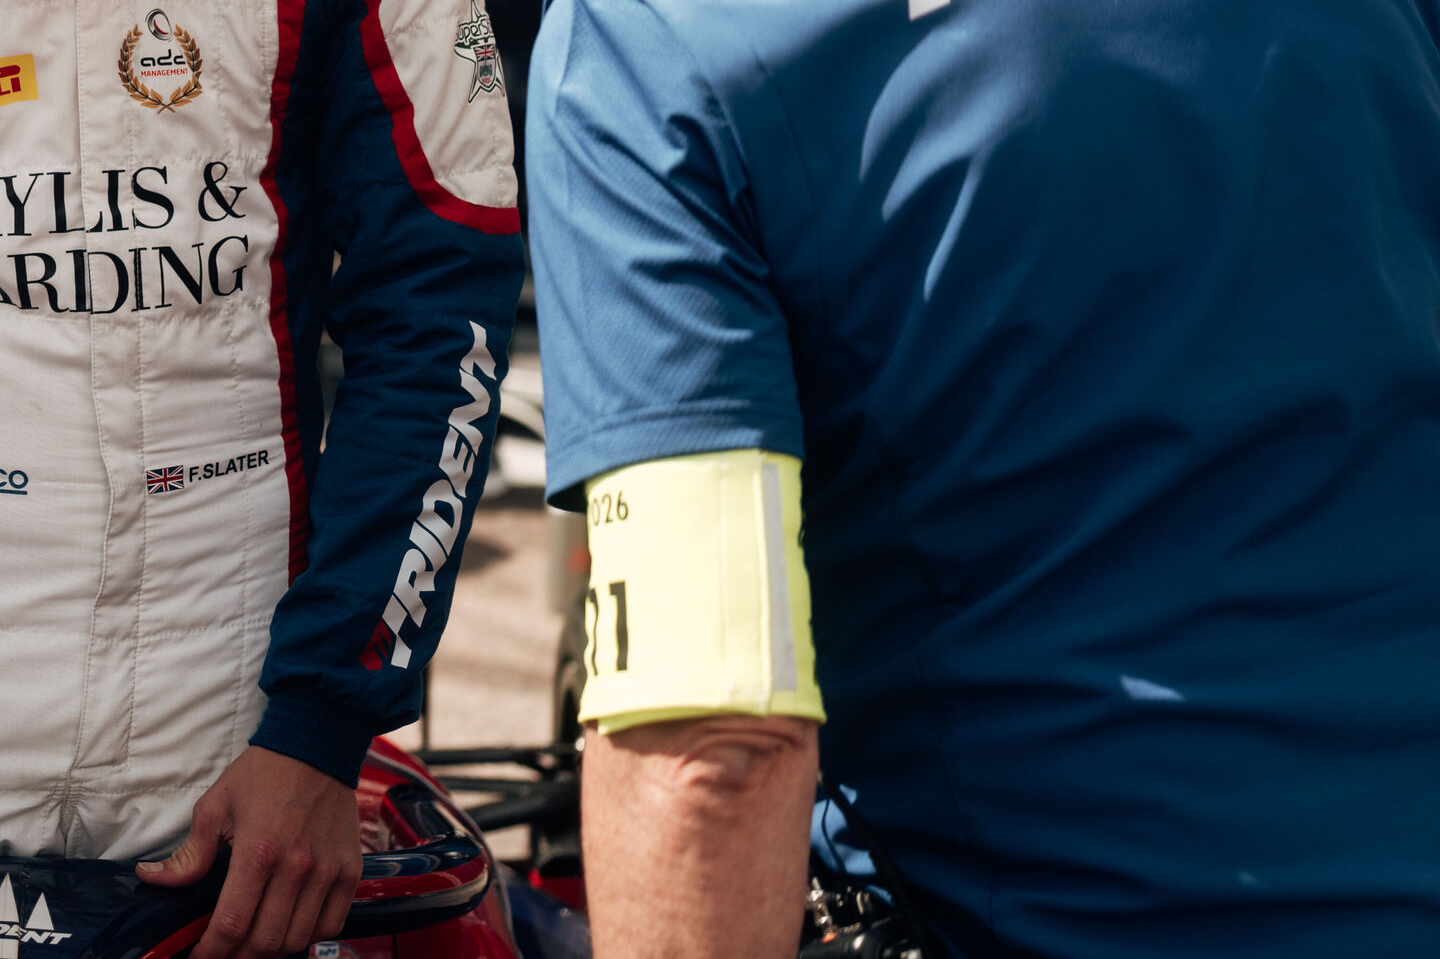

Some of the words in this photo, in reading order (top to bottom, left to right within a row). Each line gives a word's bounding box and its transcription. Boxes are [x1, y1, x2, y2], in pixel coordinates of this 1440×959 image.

[140, 48, 186, 67] adc
[141, 68, 188, 77] MANAGEMENT
[198, 161, 248, 222] &
[189, 450, 269, 483] F.SLATER
[360, 320, 497, 671] TRIDENT
